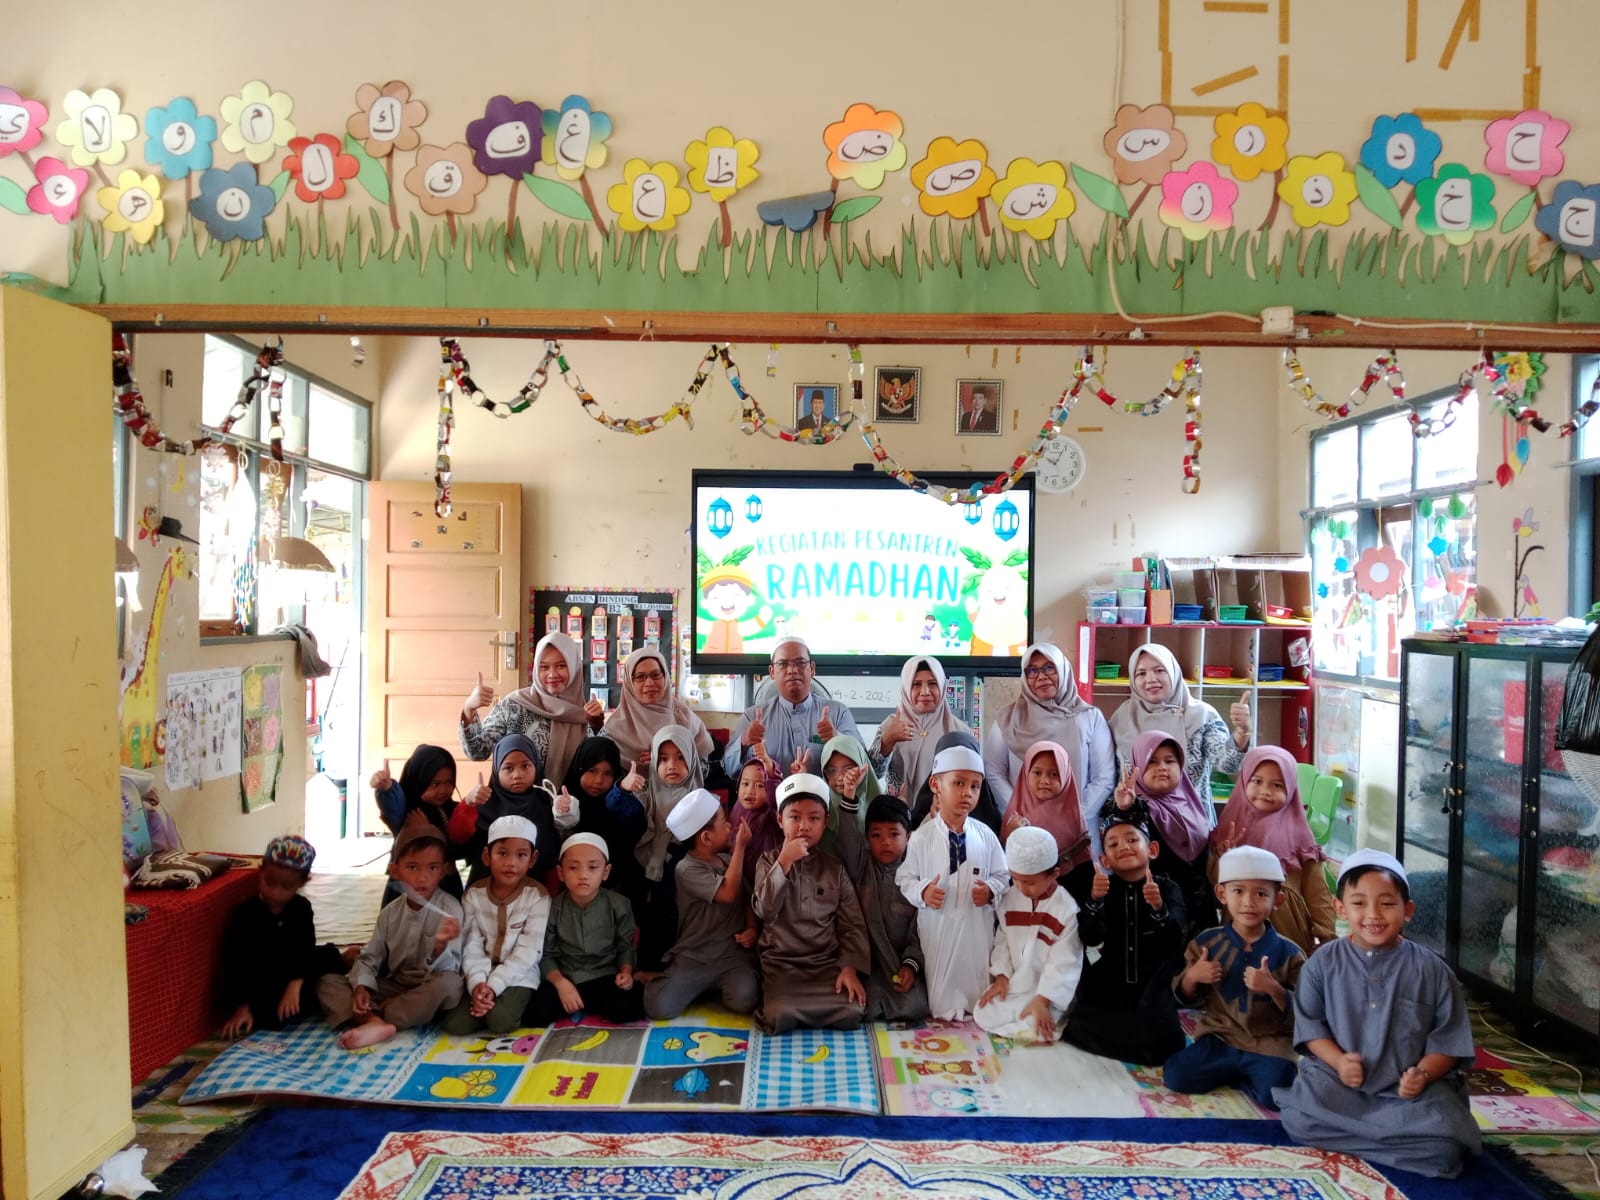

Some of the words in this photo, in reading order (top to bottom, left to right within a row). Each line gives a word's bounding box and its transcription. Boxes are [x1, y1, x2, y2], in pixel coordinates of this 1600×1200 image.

[84, 115, 106, 146] لا
[250, 108, 264, 140] م
[373, 103, 396, 133] ك
[171, 125, 188, 151] و
[490, 125, 526, 154] ف
[559, 113, 582, 163] غ
[841, 134, 888, 160] ض
[1124, 136, 1161, 155] س
[1244, 130, 1256, 153] ر
[1393, 143, 1407, 161] د
[1511, 132, 1537, 164] ح
[307, 147, 327, 187] ل
[428, 165, 455, 193] ق
[708, 154, 735, 186] ظ
[931, 167, 976, 192] ص
[223, 191, 243, 218] ن
[636, 179, 661, 218] ع
[1010, 187, 1048, 216] ش
[1191, 185, 1205, 217] ز
[1310, 178, 1324, 204] ذ
[1441, 184, 1465, 225] خ
[128, 195, 147, 217] ه
[1565, 206, 1590, 239] ج
[756, 530, 846, 556] KEGIATAN
[855, 530, 958, 558] PESANTREN
[767, 560, 959, 602] RAMADHAN
